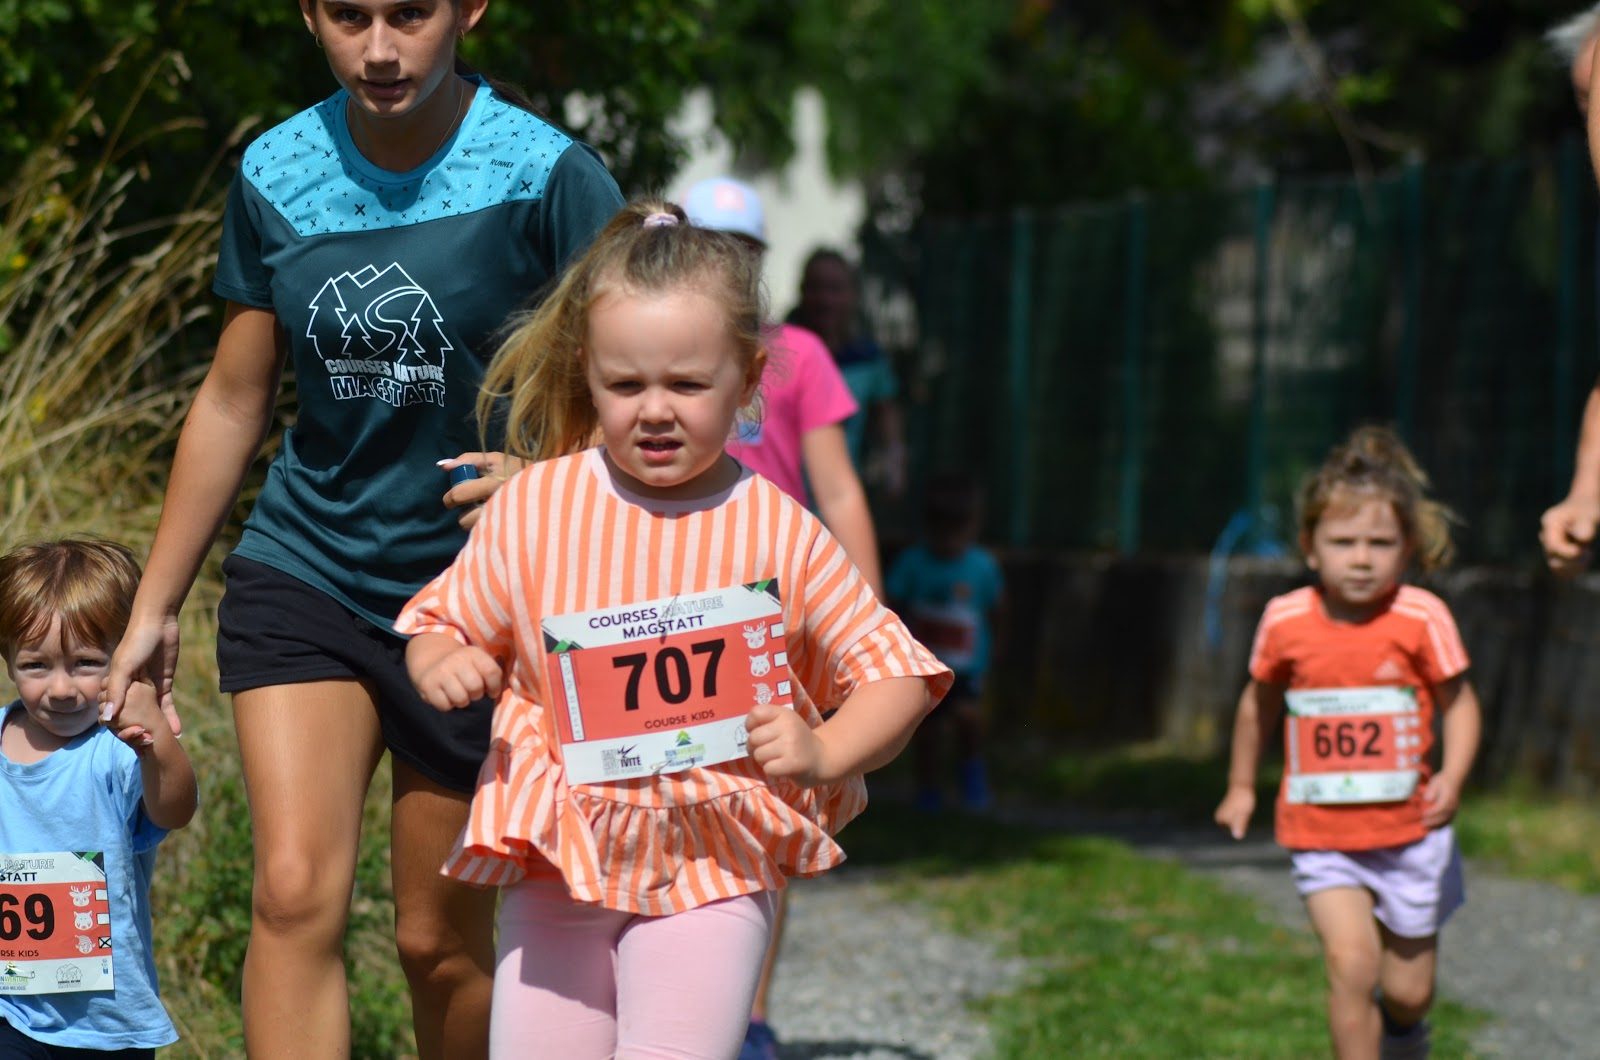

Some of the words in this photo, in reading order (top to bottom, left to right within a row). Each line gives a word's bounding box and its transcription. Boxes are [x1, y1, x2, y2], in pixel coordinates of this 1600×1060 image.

[325, 359, 393, 375] COURSES
[393, 361, 446, 384] NATURE
[330, 375, 446, 408] MAGSTATT
[588, 607, 658, 630] COURSES
[661, 596, 725, 621] NATURE
[622, 615, 705, 639] MAGSTATT
[612, 638, 726, 712] 707
[644, 713, 688, 730] COURSE
[691, 709, 716, 722] KIDS
[1314, 720, 1383, 759] 662
[3, 858, 55, 871] NATURE
[0, 893, 55, 941] 69
[18, 949, 40, 958] KIDS
